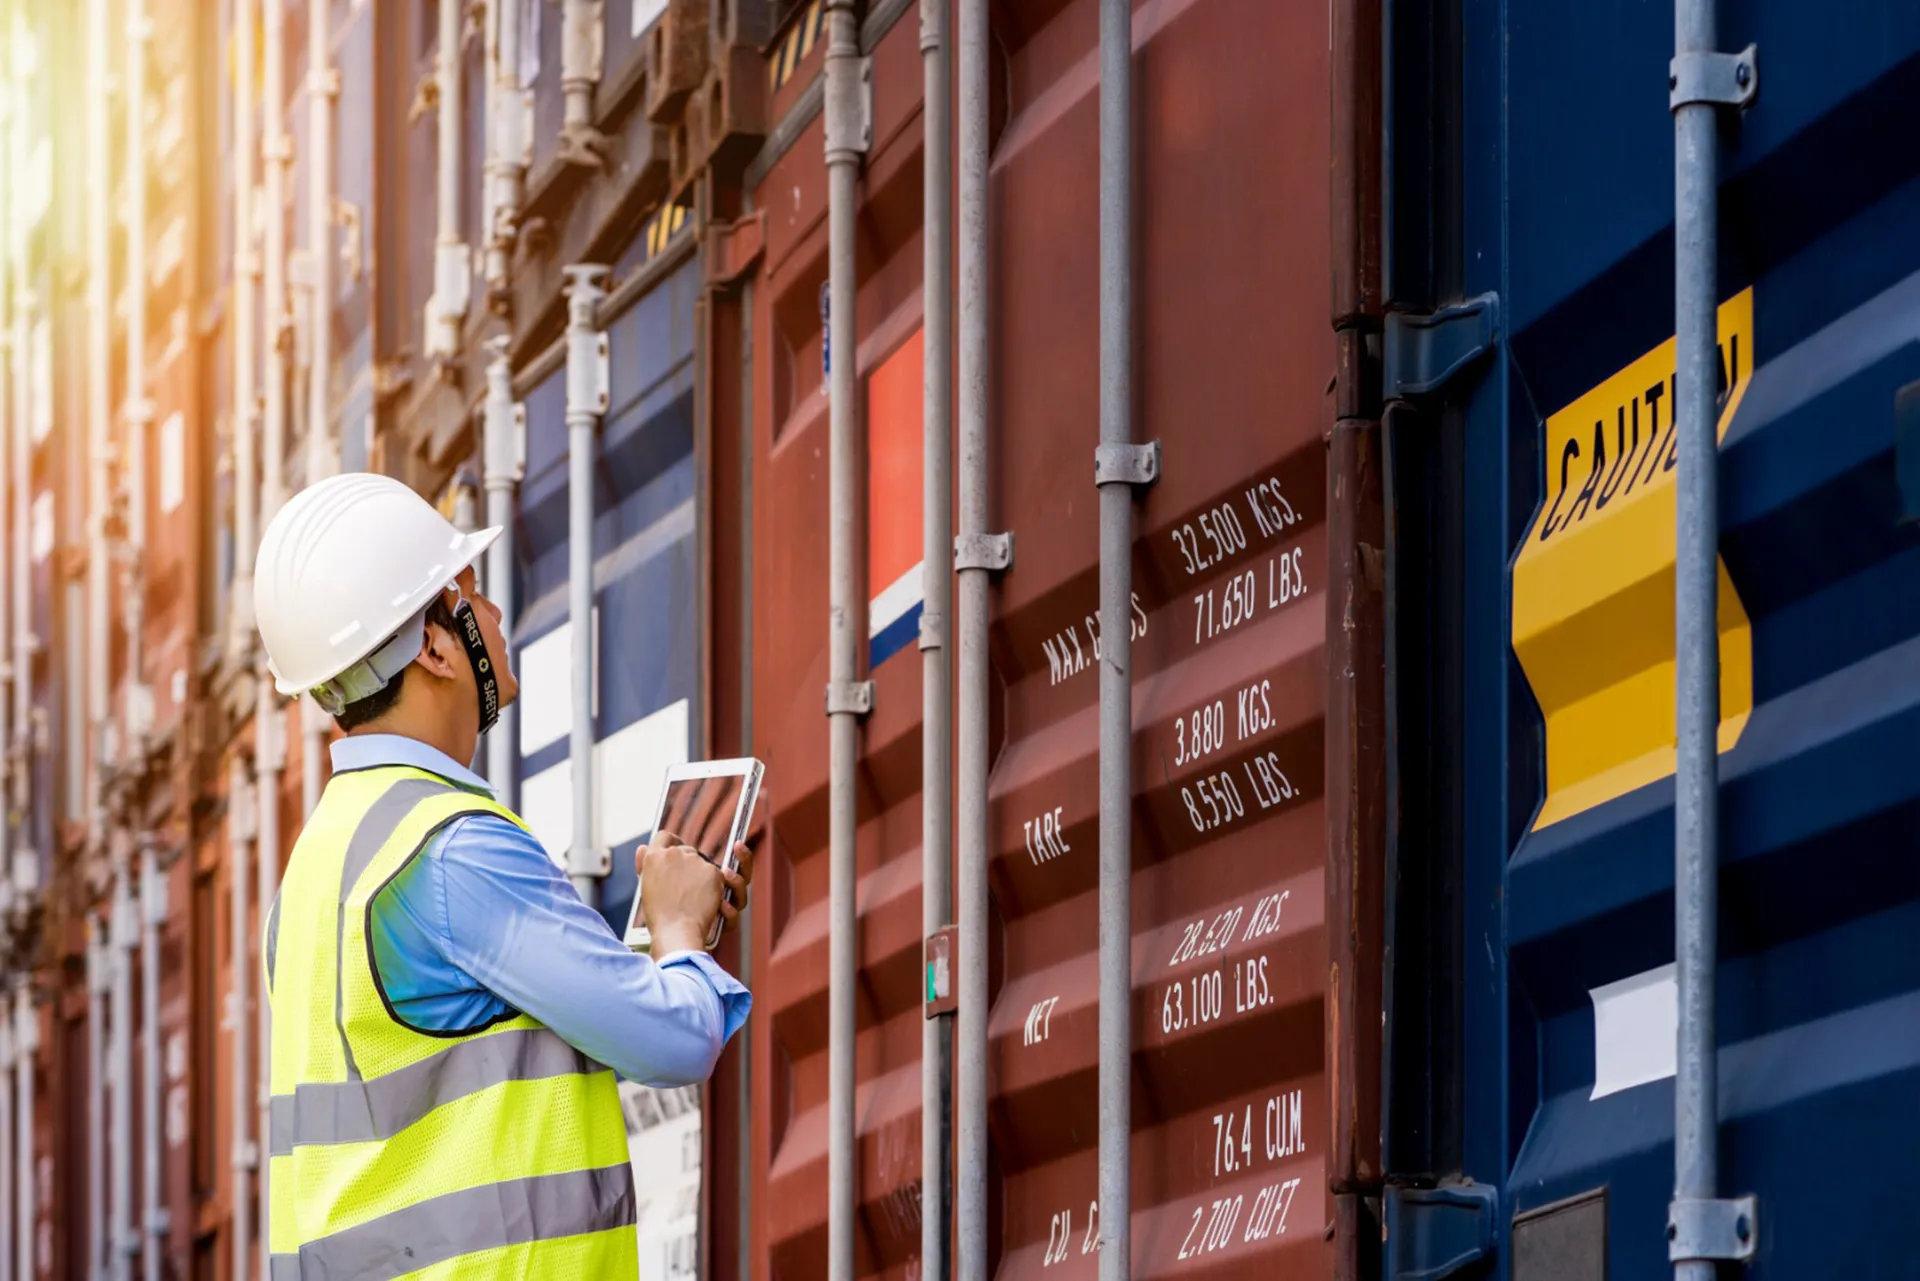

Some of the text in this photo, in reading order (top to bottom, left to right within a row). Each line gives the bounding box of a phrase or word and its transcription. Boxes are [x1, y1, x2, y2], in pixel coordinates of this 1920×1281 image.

[1539, 333, 1738, 541] CAUTIN
[1172, 476, 1303, 576] 32,500 KGS.
[1193, 546, 1308, 645] 71,650 LBS.
[463, 611, 497, 721] FIRST SAFETY
[1174, 679, 1277, 767] 3,880 KGS.
[1181, 751, 1301, 833] 8,550 LBS.
[1023, 806, 1071, 866] TARE
[1168, 889, 1290, 967] 28,620 KGS.
[1024, 996, 1060, 1047] NET
[1162, 955, 1275, 1034] 63,100 LBS.
[1213, 1089, 1305, 1177] 76.4 CU.M.
[1043, 1208, 1070, 1268] CU.
